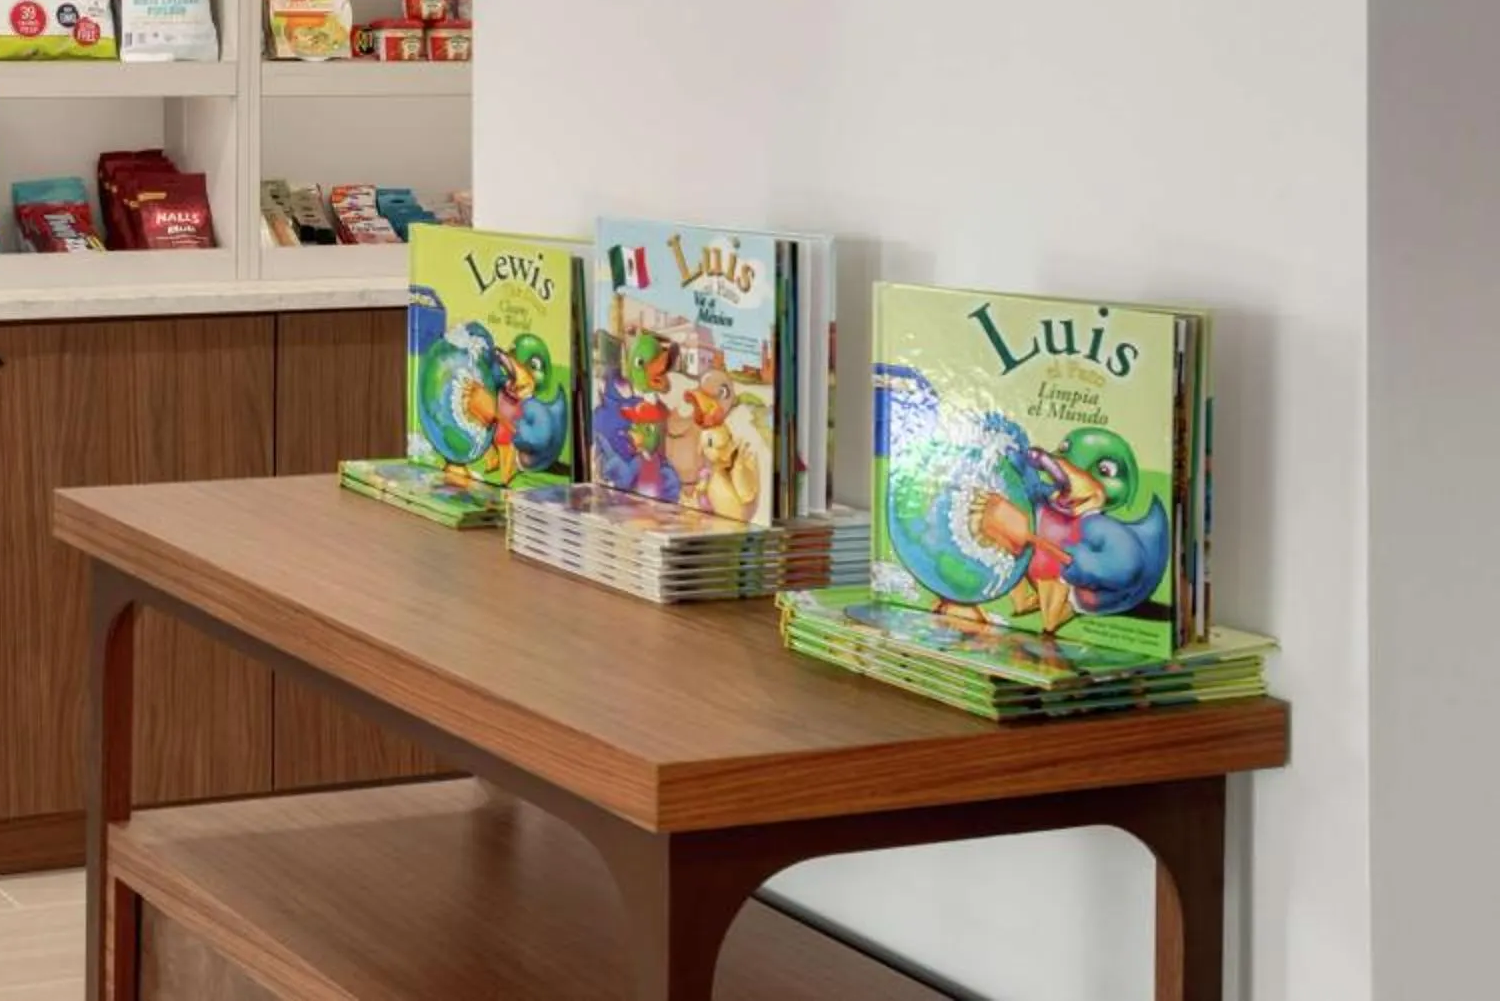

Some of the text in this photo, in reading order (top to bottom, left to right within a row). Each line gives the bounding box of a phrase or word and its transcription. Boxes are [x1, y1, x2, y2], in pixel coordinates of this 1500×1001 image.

[19, 5, 37, 20] 39
[156, 211, 200, 224] HALLS
[465, 251, 555, 300] Lewis
[666, 233, 755, 294] Luis
[968, 302, 1139, 378] Luis
[1037, 381, 1099, 408] Limpia
[1027, 401, 1109, 426] el Mundo
